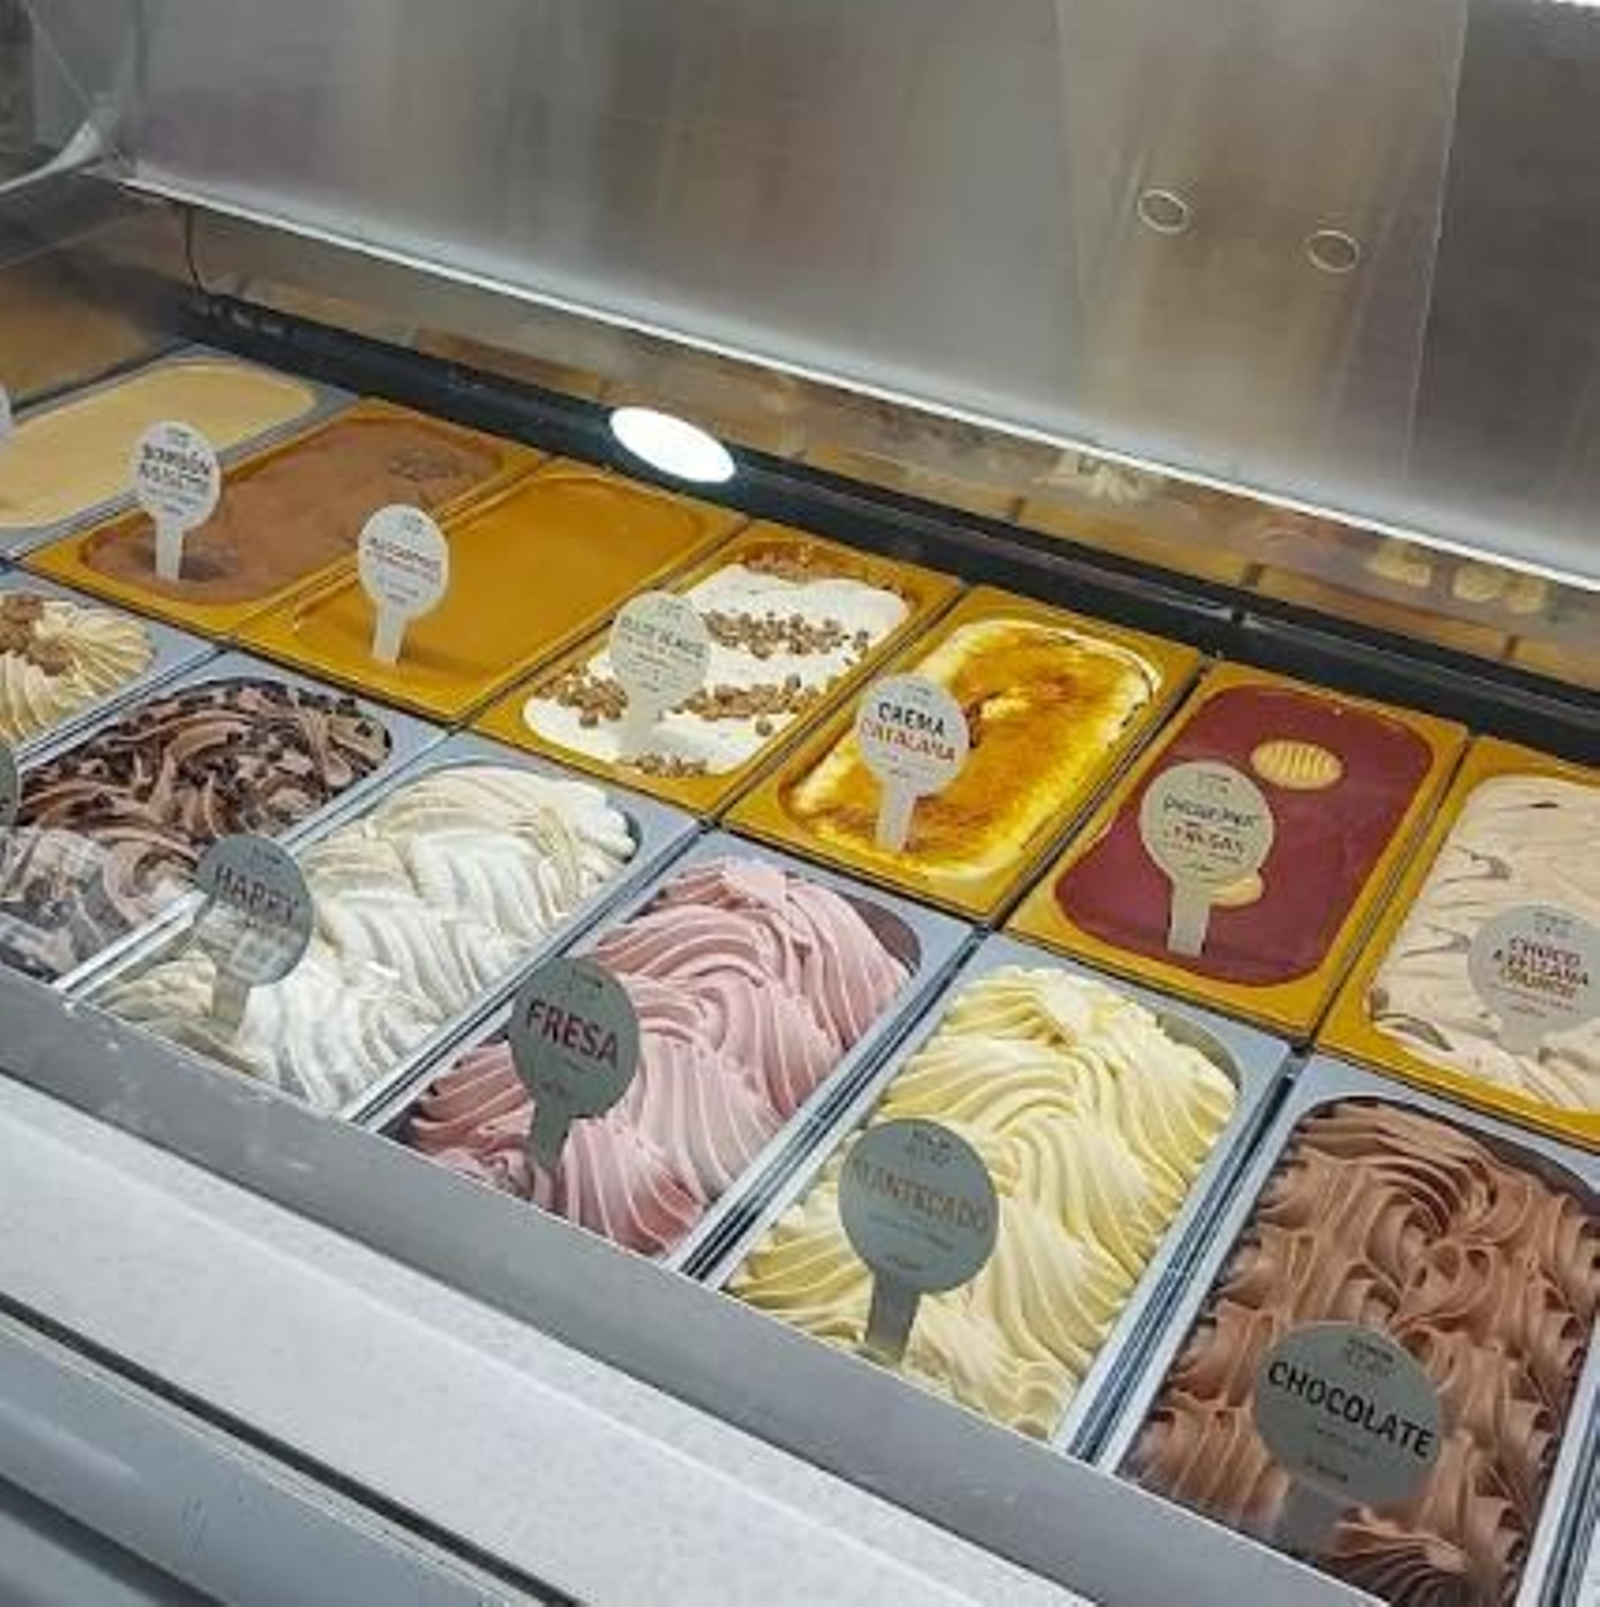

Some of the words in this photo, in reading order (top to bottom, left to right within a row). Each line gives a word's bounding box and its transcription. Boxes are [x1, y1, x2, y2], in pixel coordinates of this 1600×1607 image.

[878, 701, 944, 738] CREMA
[215, 863, 300, 922] HAPPY
[527, 999, 619, 1071] FRESA
[1267, 1360, 1435, 1460] CHOCOLATE
